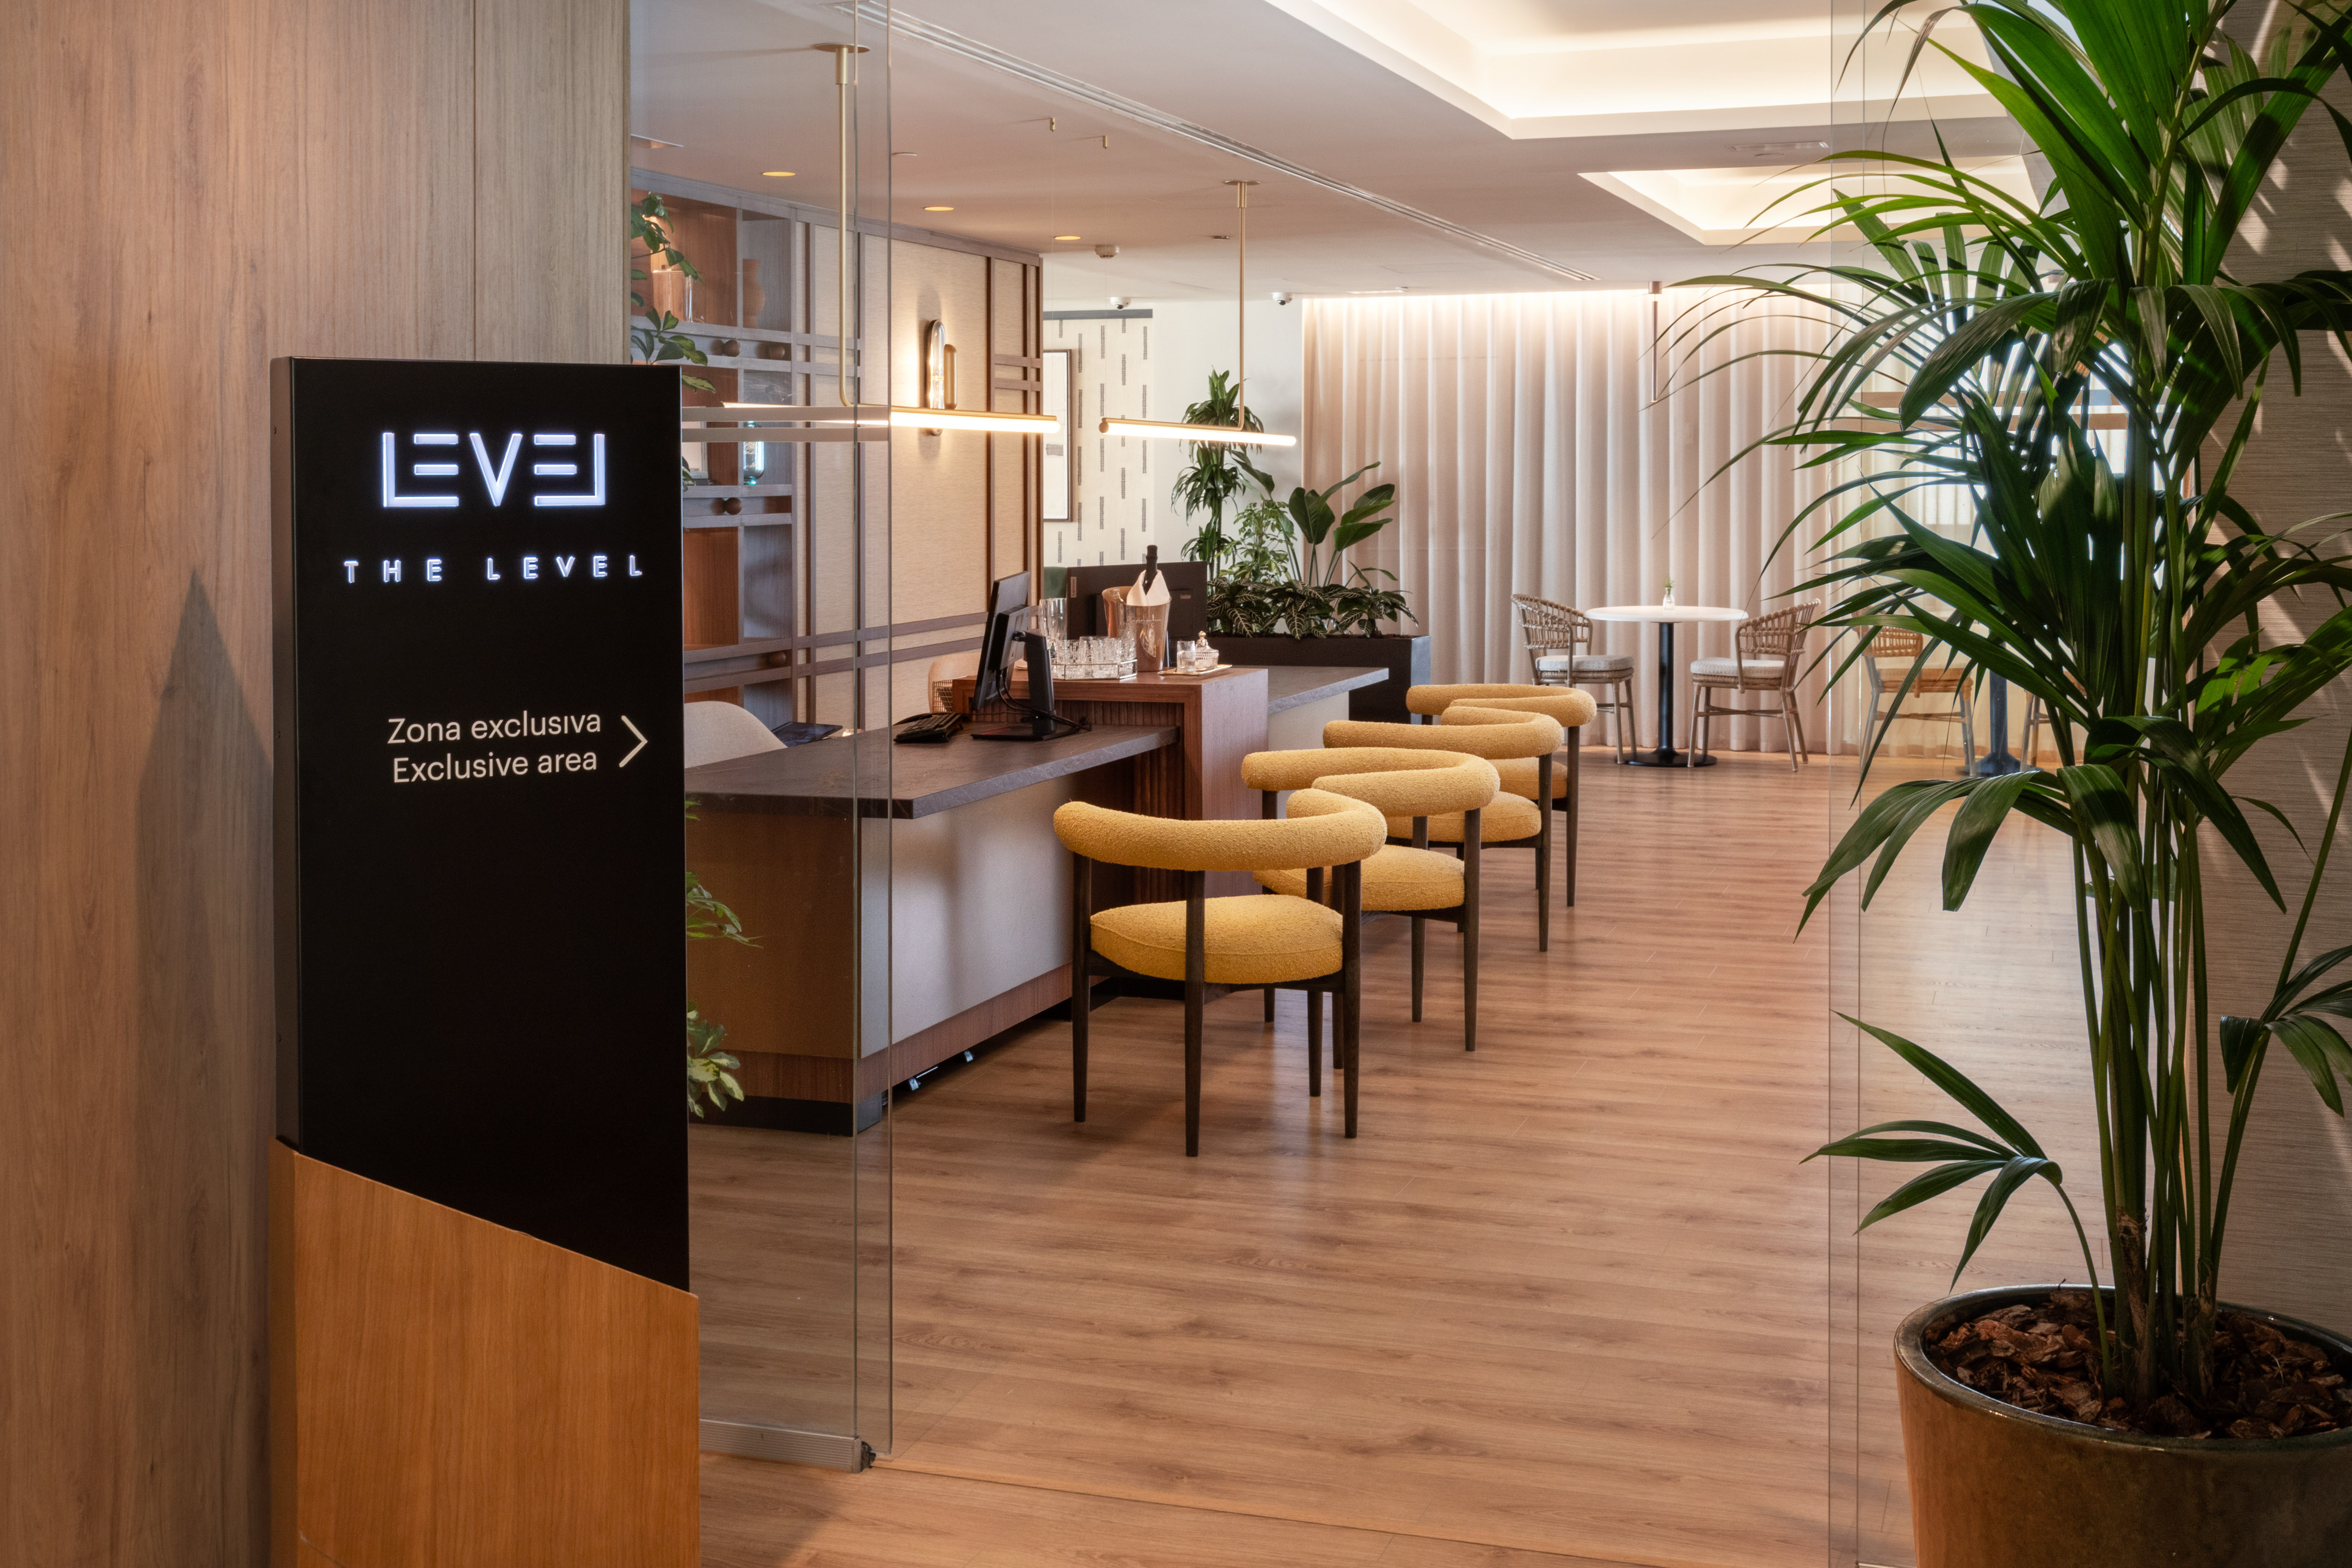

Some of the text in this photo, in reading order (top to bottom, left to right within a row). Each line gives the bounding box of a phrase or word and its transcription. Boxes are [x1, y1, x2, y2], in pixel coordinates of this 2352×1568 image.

[382, 433, 606, 508] LEVEL
[344, 555, 643, 583] THE LEVEL
[387, 710, 601, 744] Zona exclusiva
[394, 752, 597, 783] Exclusive area
